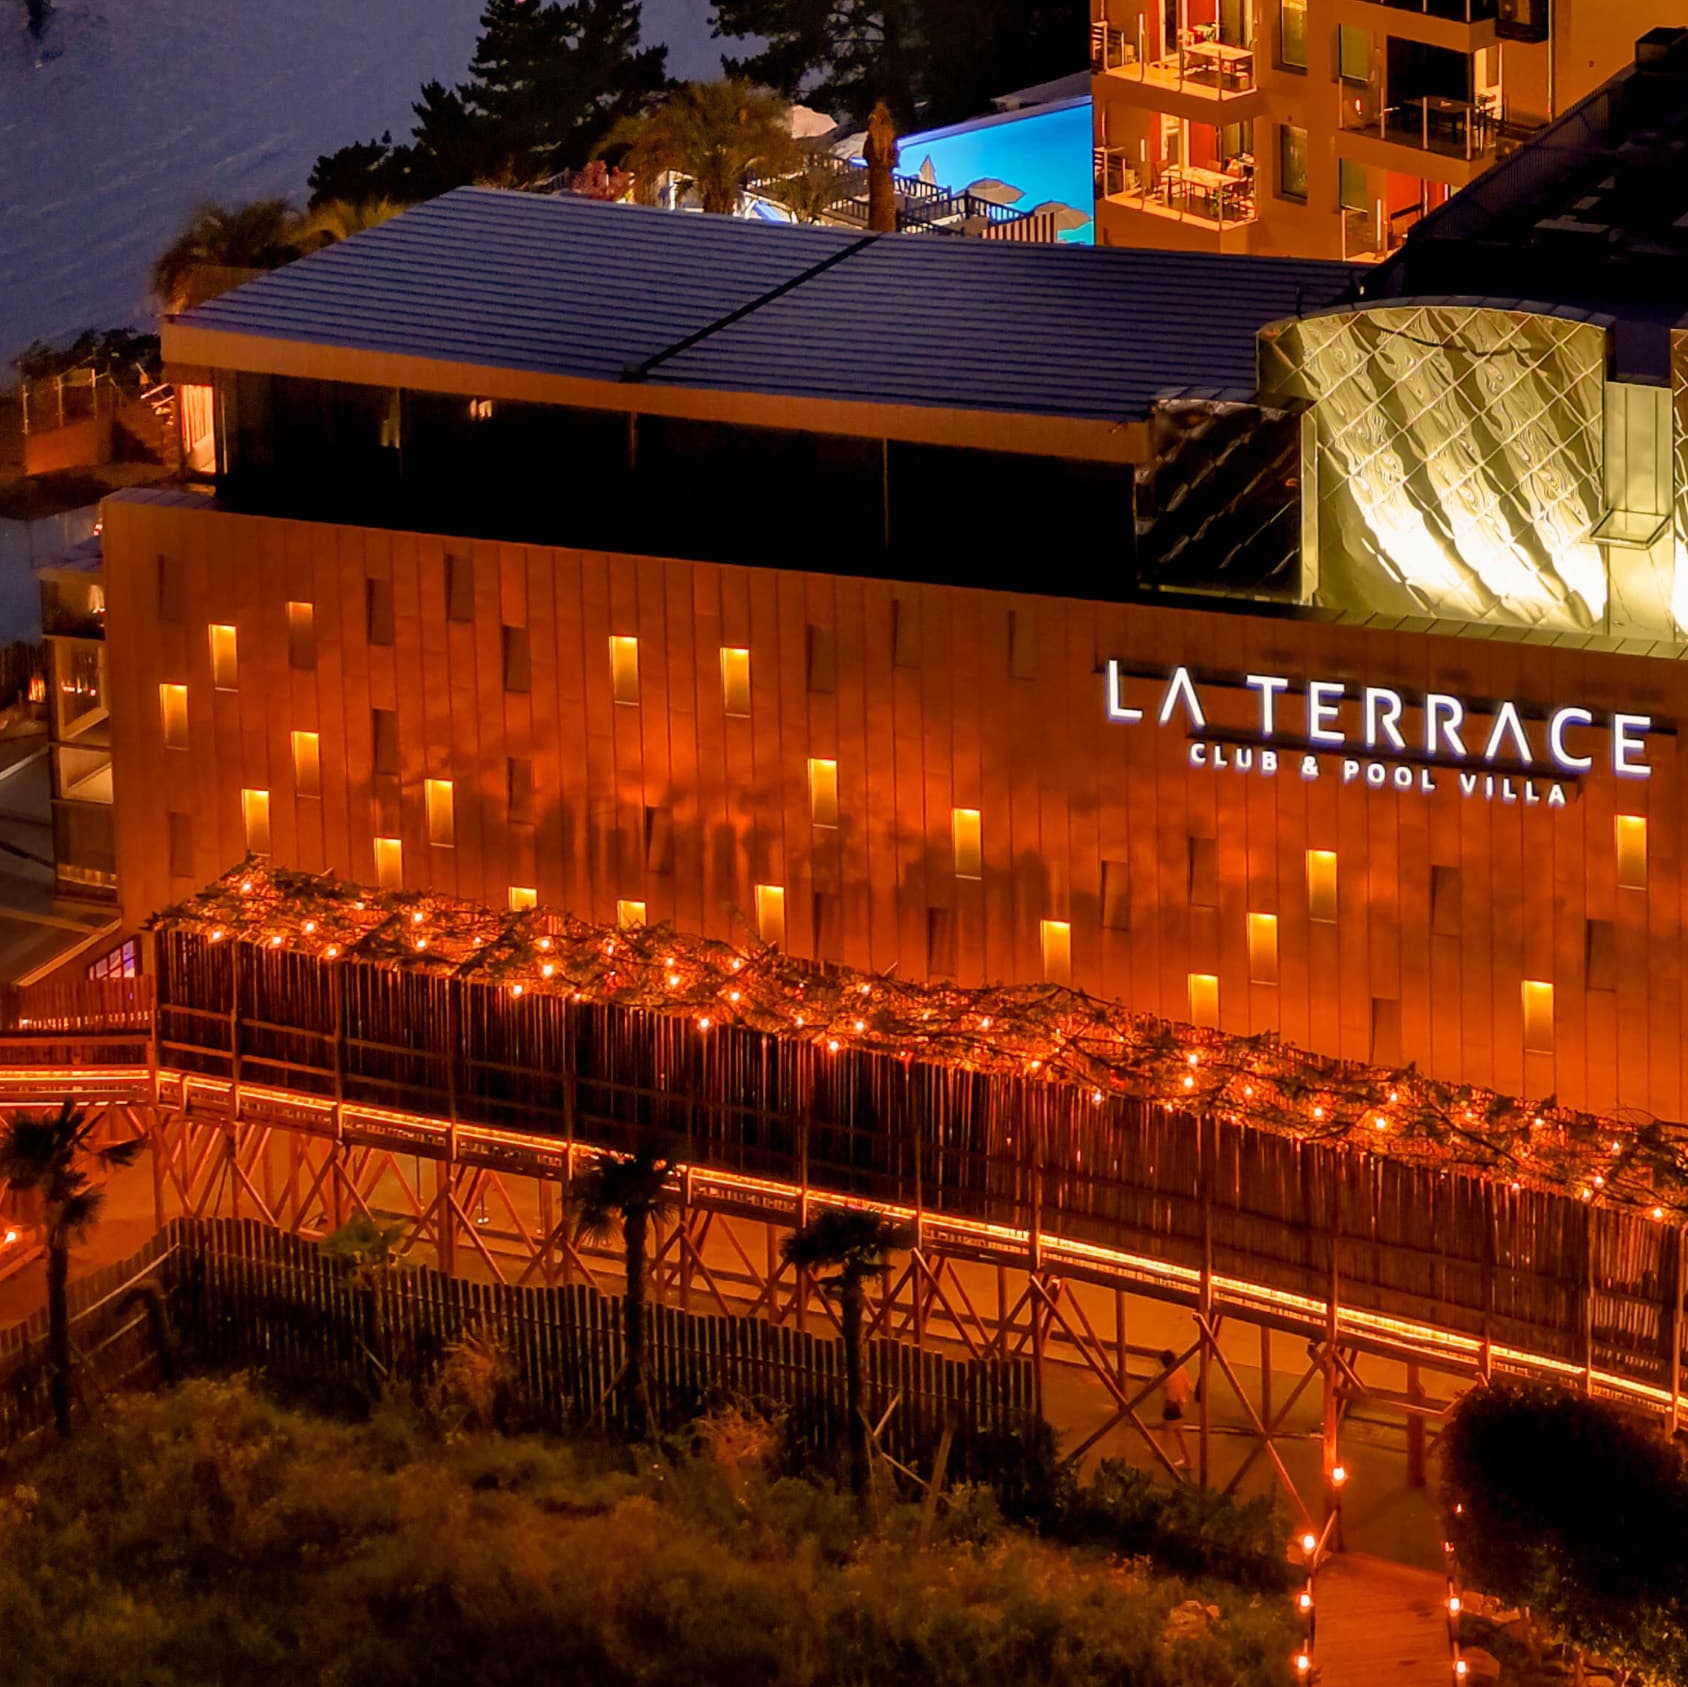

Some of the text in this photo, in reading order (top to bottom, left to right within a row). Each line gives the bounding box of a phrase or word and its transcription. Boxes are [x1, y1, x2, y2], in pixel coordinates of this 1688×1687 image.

[1109, 660, 1652, 776] LA TERRACE
[1190, 743, 1566, 805] CLUB & POOL VILLA
